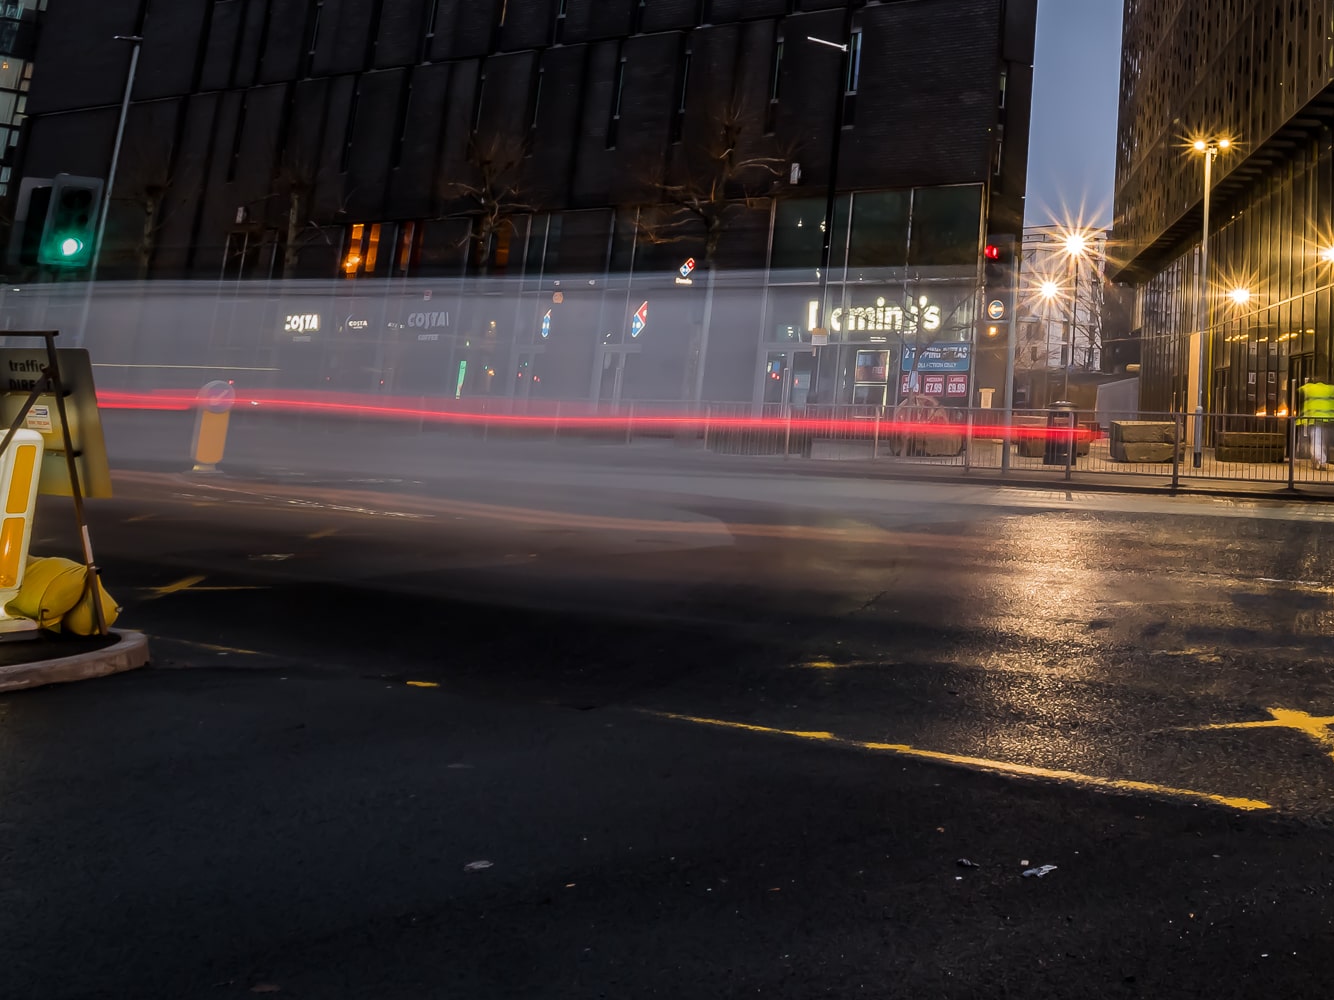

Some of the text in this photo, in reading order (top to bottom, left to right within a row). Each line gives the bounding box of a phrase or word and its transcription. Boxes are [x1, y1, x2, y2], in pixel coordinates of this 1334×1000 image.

[284, 314, 319, 332] COSTA
[348, 320, 368, 328] COSTA
[408, 312, 446, 329] COSTA
[9, 359, 46, 373] traffic
